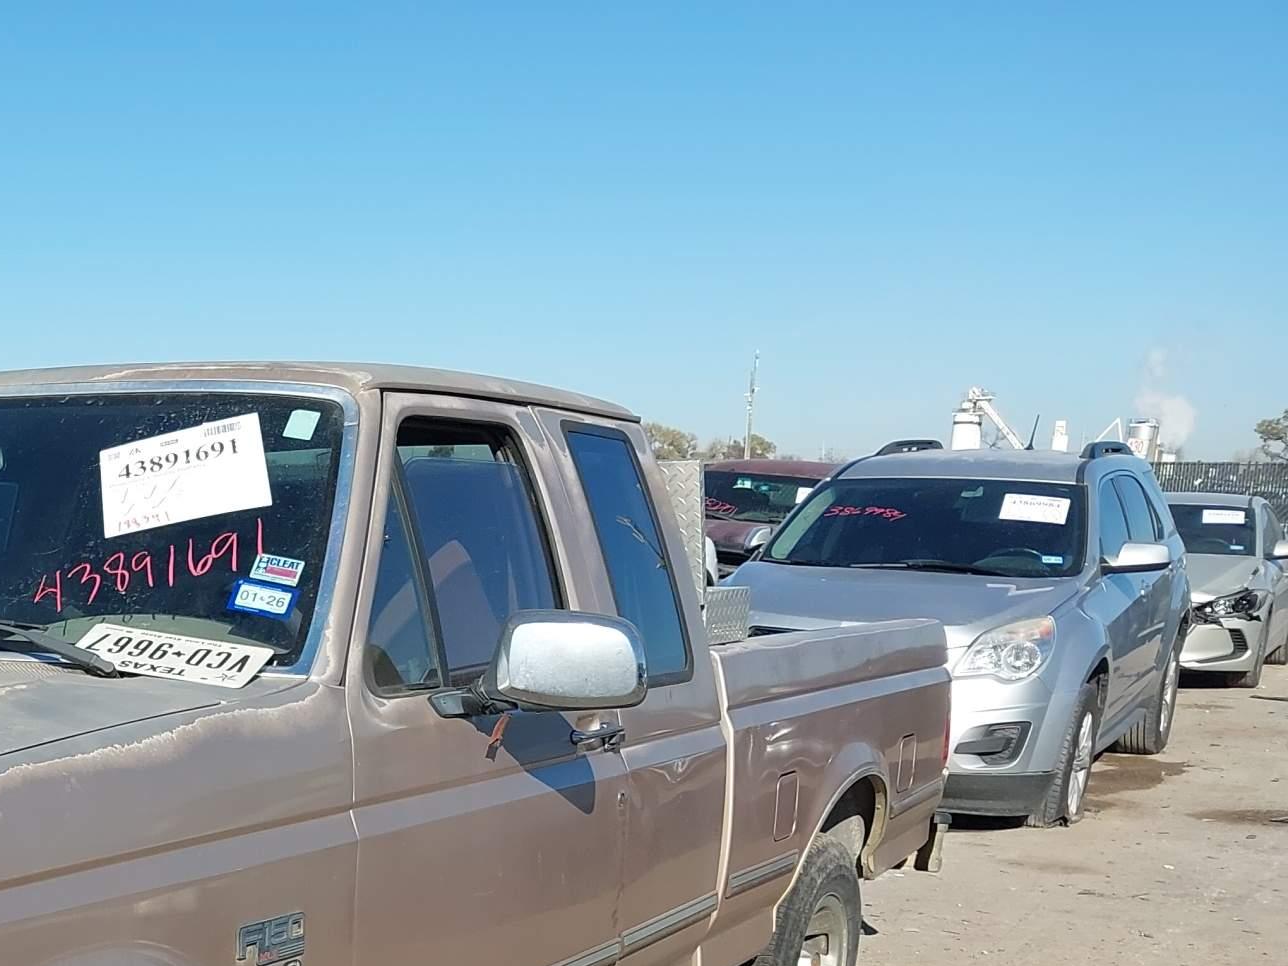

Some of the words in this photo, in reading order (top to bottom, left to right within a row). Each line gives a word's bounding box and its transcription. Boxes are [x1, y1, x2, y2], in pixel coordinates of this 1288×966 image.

[118, 438, 240, 479] 43891691
[34, 517, 263, 614] 43891691
[118, 659, 186, 677] TEXAS
